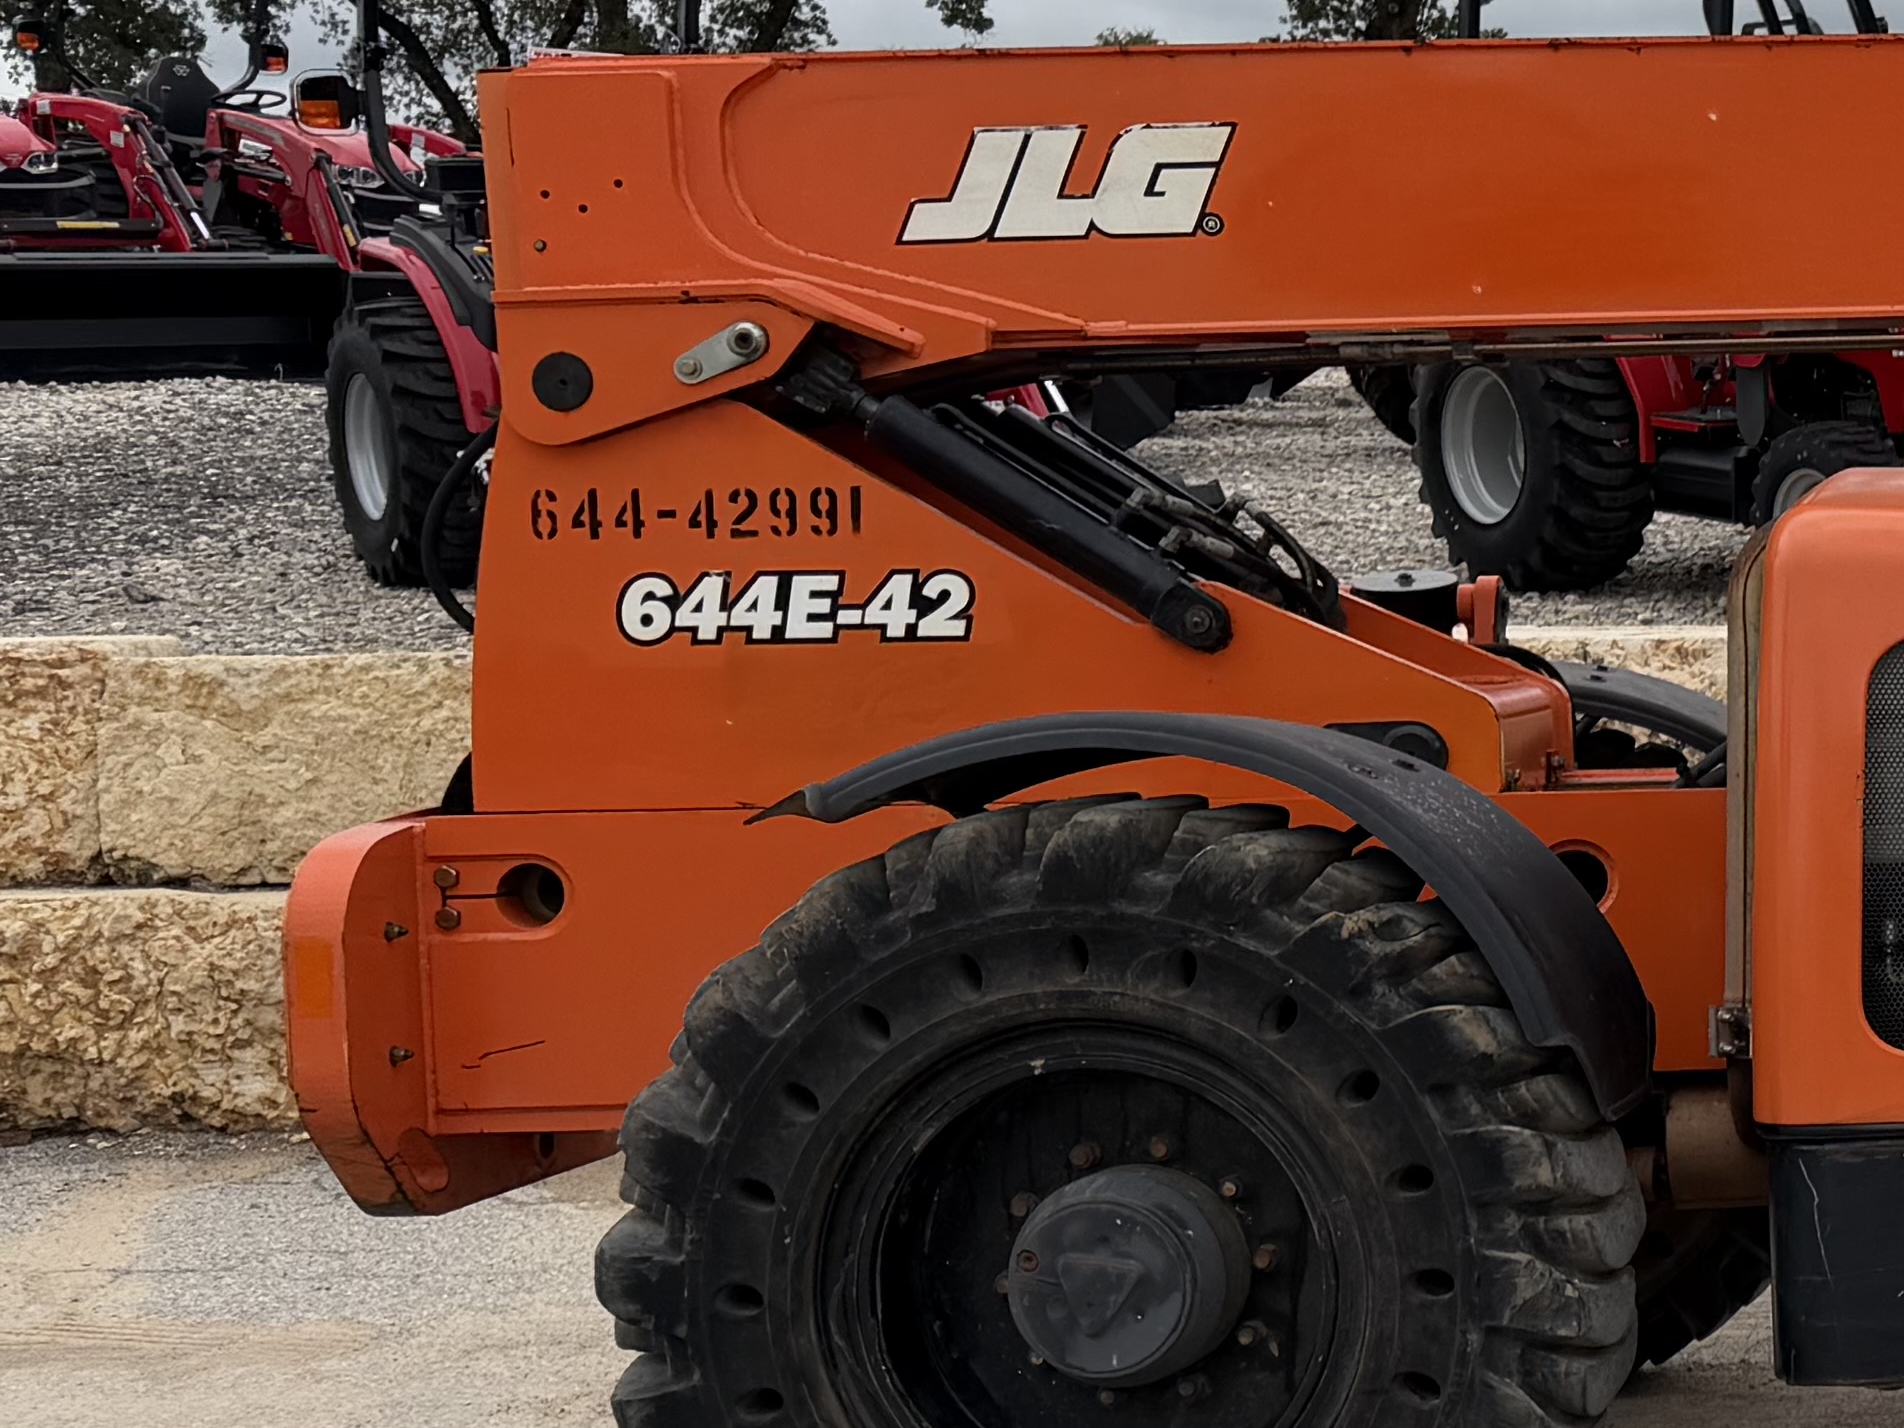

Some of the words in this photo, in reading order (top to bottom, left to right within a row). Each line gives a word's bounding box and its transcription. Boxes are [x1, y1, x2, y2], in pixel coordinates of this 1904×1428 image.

[895, 121, 1238, 245] JLG
[530, 485, 862, 541] 644-42991
[616, 568, 976, 647] 644E-42
